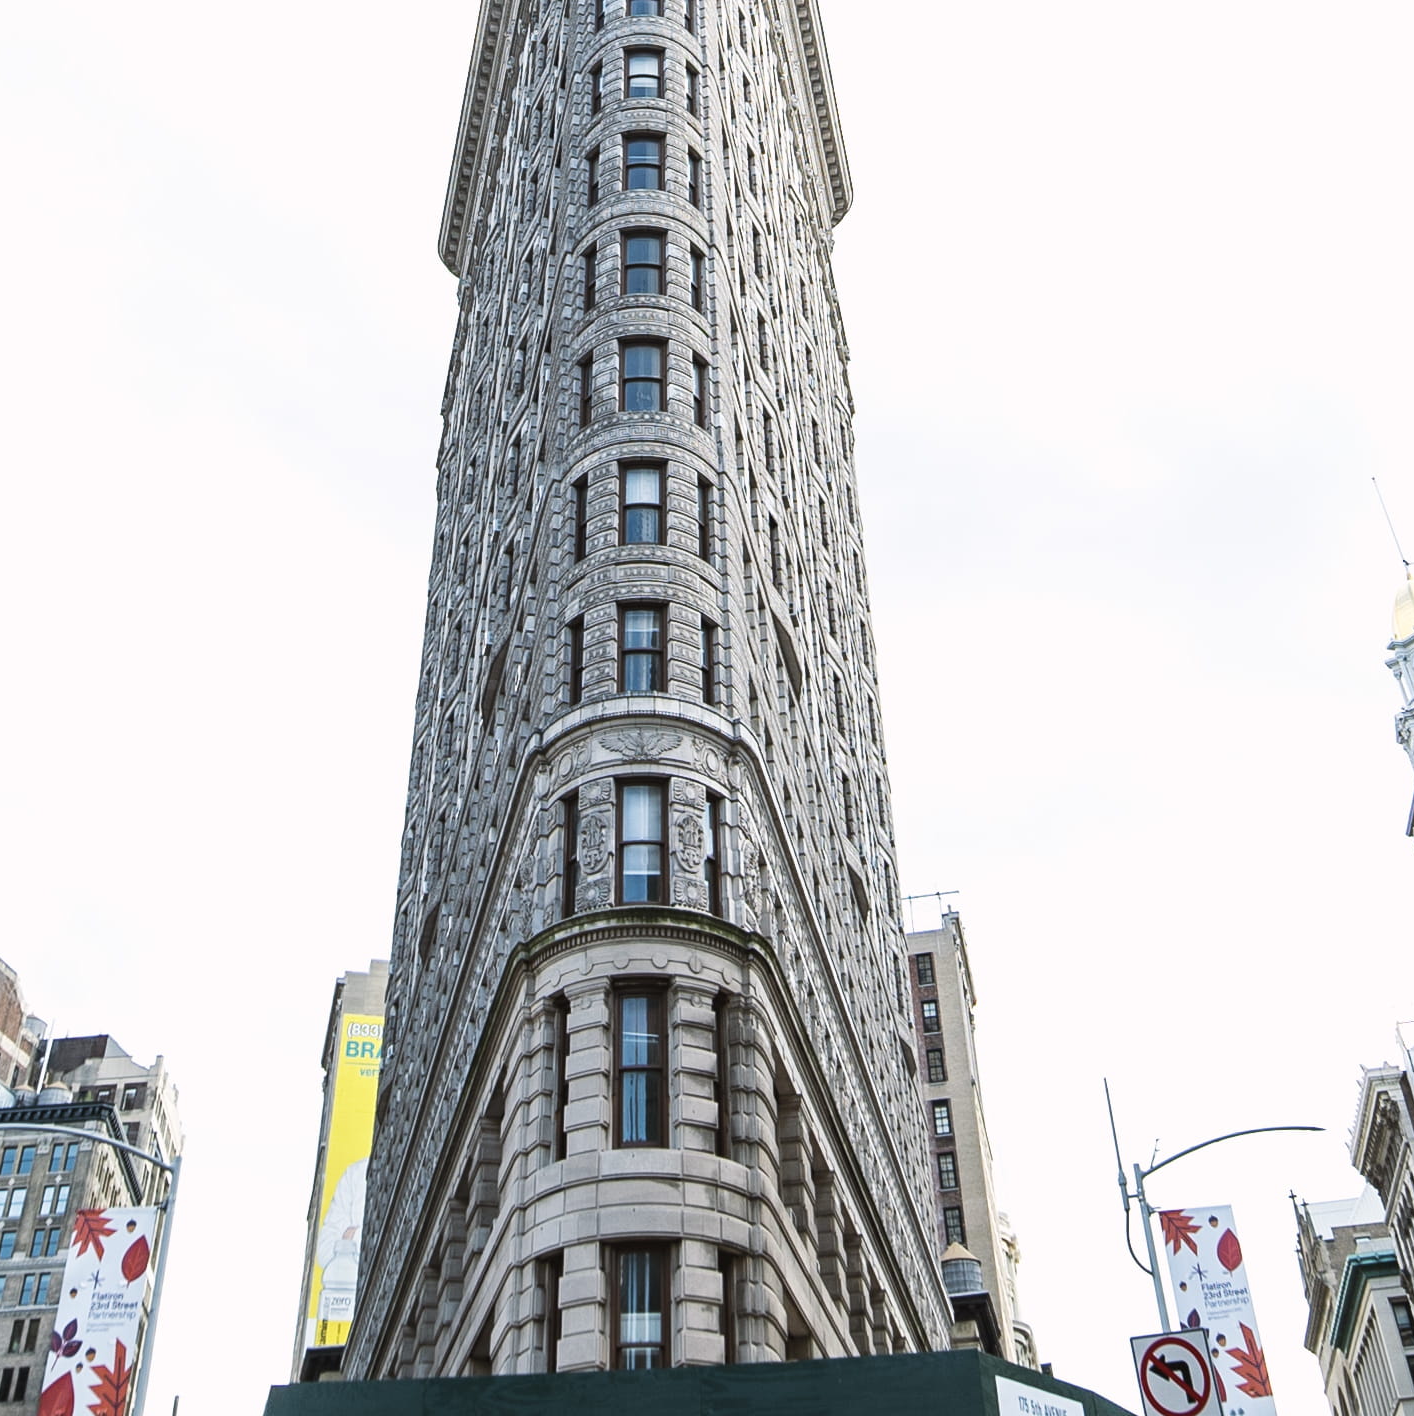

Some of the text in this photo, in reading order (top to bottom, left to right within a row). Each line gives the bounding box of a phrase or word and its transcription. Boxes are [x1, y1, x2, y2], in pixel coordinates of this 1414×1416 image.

[1201, 1281, 1232, 1290] Flatiron
[91, 1292, 124, 1300] Flatiron
[1203, 1287, 1249, 1300] 23rd Street
[90, 1301, 138, 1310] 23rd Street
[1205, 1296, 1250, 1308] Partnership
[88, 1311, 136, 1321] Partnership
[1018, 1395, 1029, 1414] 175
